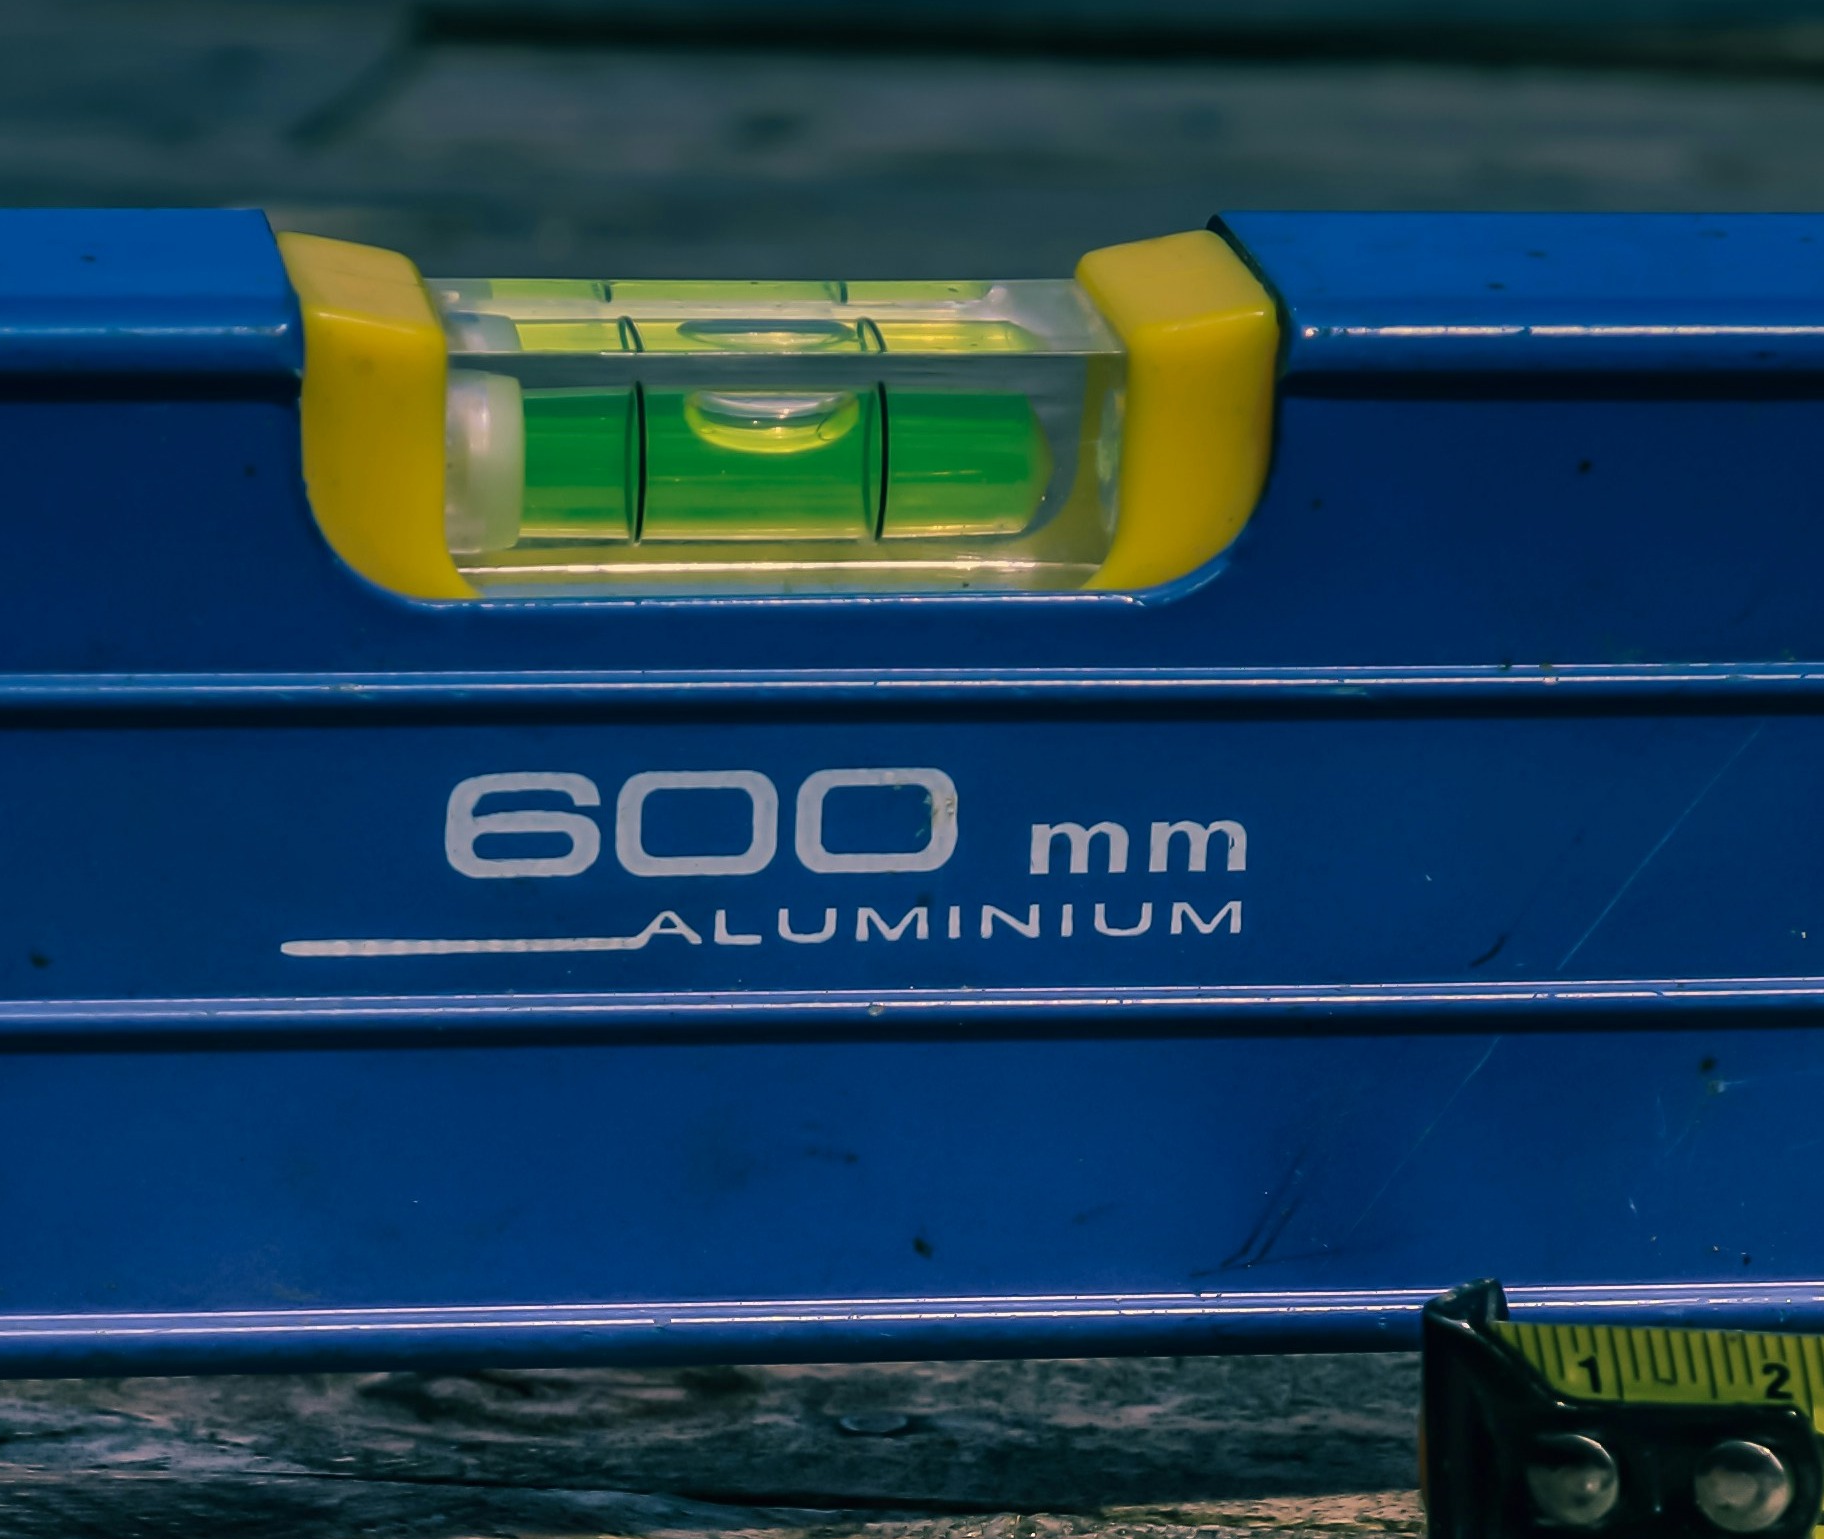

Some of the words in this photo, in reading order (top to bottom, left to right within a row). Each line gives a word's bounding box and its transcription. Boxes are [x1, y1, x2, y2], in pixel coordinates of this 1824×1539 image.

[445, 767, 957, 878] 600
[1029, 818, 1246, 874] mm
[638, 900, 1243, 946] ALUMINIUM
[1578, 1356, 1602, 1393] 1
[1762, 1362, 1791, 1400] 2
